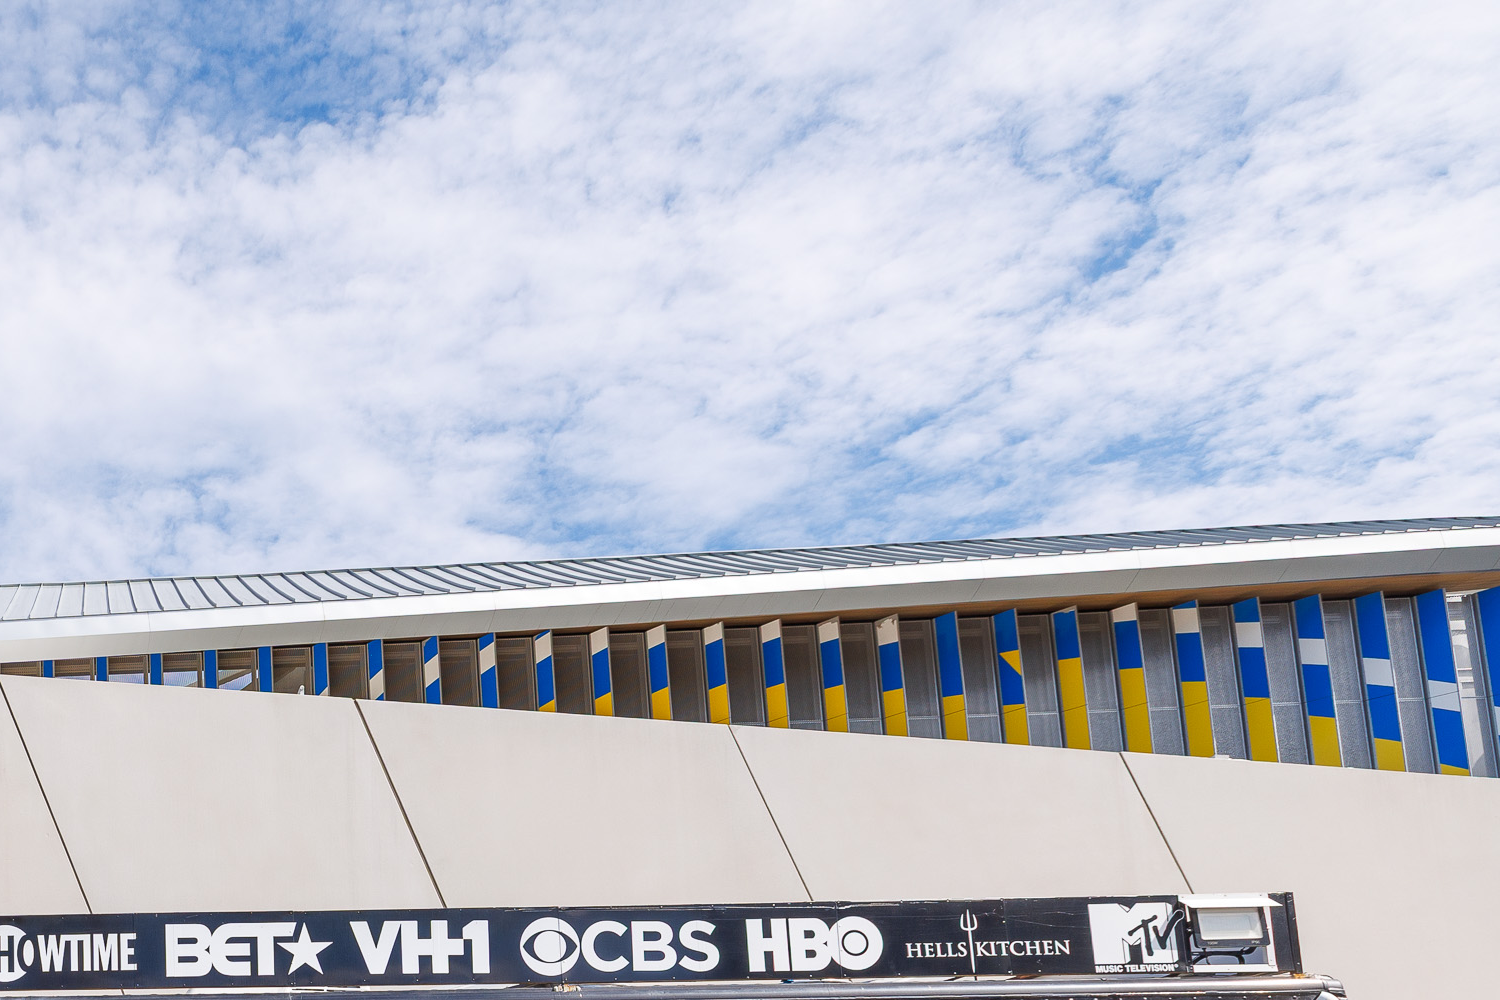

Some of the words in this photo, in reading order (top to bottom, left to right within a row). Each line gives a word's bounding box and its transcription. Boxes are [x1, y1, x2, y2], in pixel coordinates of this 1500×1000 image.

[349, 919, 490, 976] VH1
[580, 918, 720, 973] CBS
[745, 916, 884, 973] HBO
[905, 941, 967, 958] HELLS
[974, 939, 1071, 957] KITCHEN
[1095, 965, 1124, 973] MUSIC
